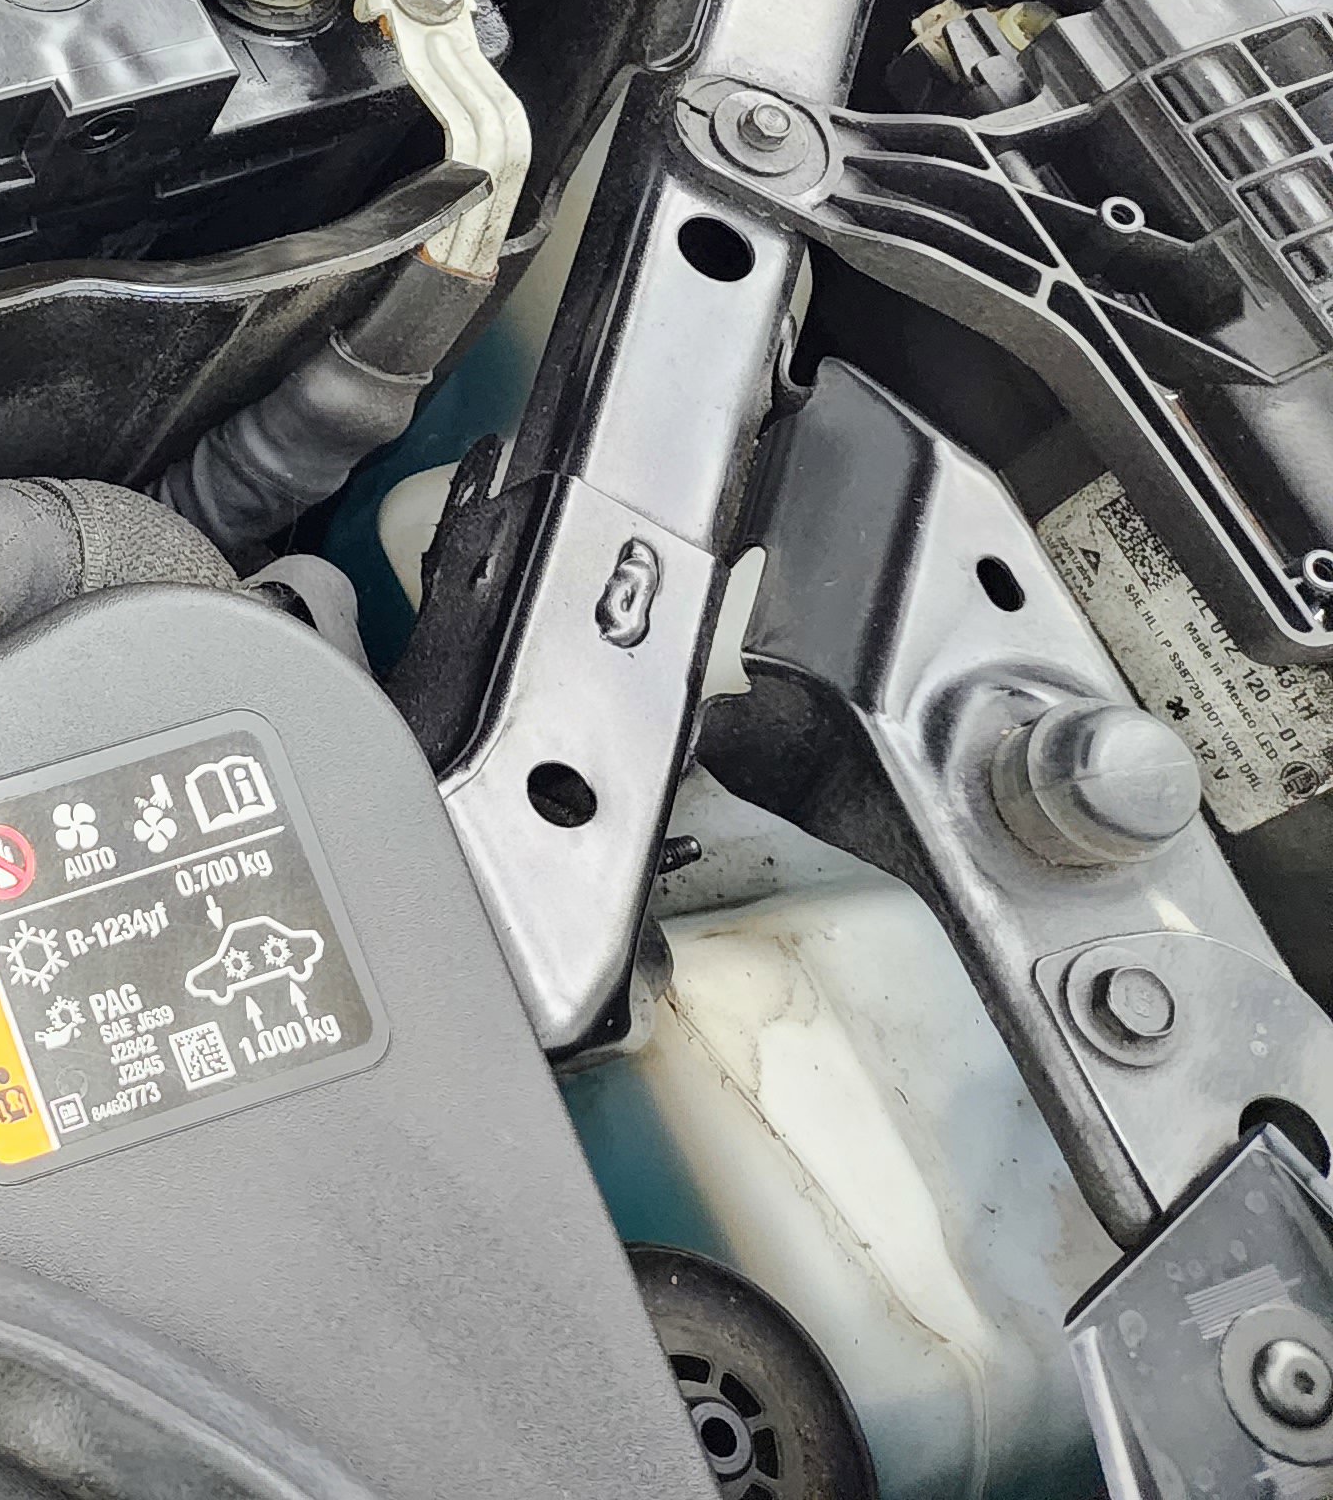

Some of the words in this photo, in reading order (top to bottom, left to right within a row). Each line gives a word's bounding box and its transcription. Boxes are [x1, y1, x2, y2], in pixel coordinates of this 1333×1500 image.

[1122, 581, 1146, 609] SAE
[1140, 609, 1159, 631] HL
[1159, 638, 1172, 651] P
[1219, 730, 1244, 761] VOR
[1182, 620, 1214, 661] Made
[1209, 661, 1225, 677] in
[1220, 677, 1259, 730] Mexico
[1253, 730, 1279, 762] LED
[1238, 664, 1272, 704] 120
[1289, 690, 1320, 723] LH
[1191, 735, 1218, 765] 12
[1210, 765, 1230, 784] V
[59, 844, 119, 882] AUTO
[171, 853, 241, 899] 0.700
[236, 843, 275, 883] kg
[63, 900, 175, 963] R-1234yf
[86, 981, 144, 1024] PAG
[97, 1015, 137, 1045] SAE
[132, 1003, 177, 1034] J639
[106, 1031, 159, 1065] J2842
[236, 1018, 309, 1067] 1.000
[303, 1008, 344, 1049] kg
[113, 1052, 167, 1087] J2845
[86, 1079, 164, 1123] 84468773
